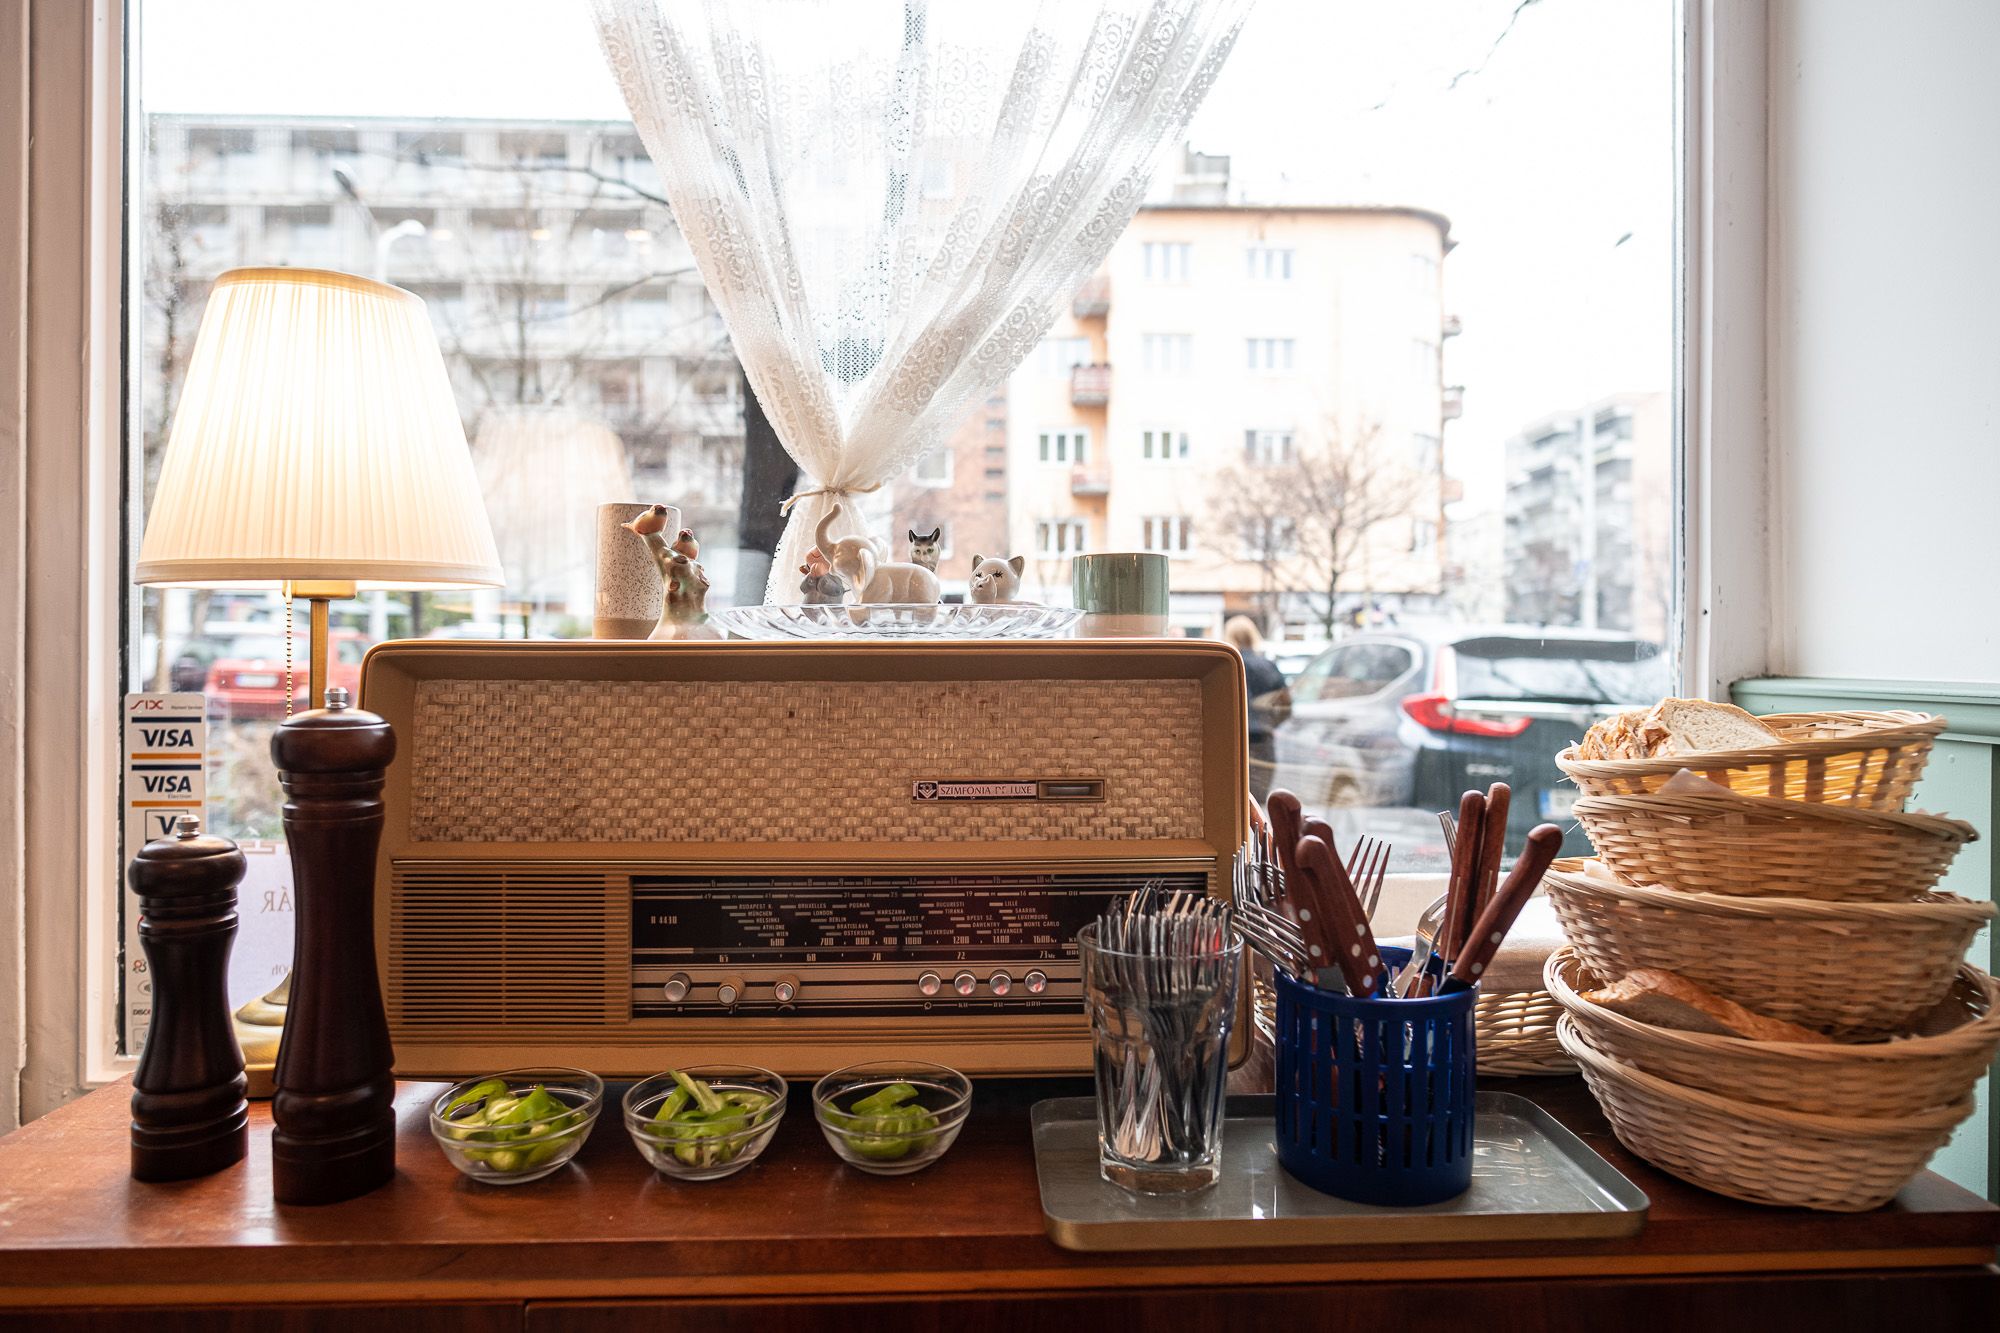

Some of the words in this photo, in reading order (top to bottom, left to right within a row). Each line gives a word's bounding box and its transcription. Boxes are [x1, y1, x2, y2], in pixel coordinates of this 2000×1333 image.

[139, 729, 194, 747] VISA
[140, 776, 192, 792] VISA
[820, 938, 834, 946] 700
[883, 937, 897, 945] 900
[953, 936, 970, 944] 1200
[992, 935, 1010, 944] 1400
[872, 953, 881, 961] 70
[957, 951, 965, 959] 72
